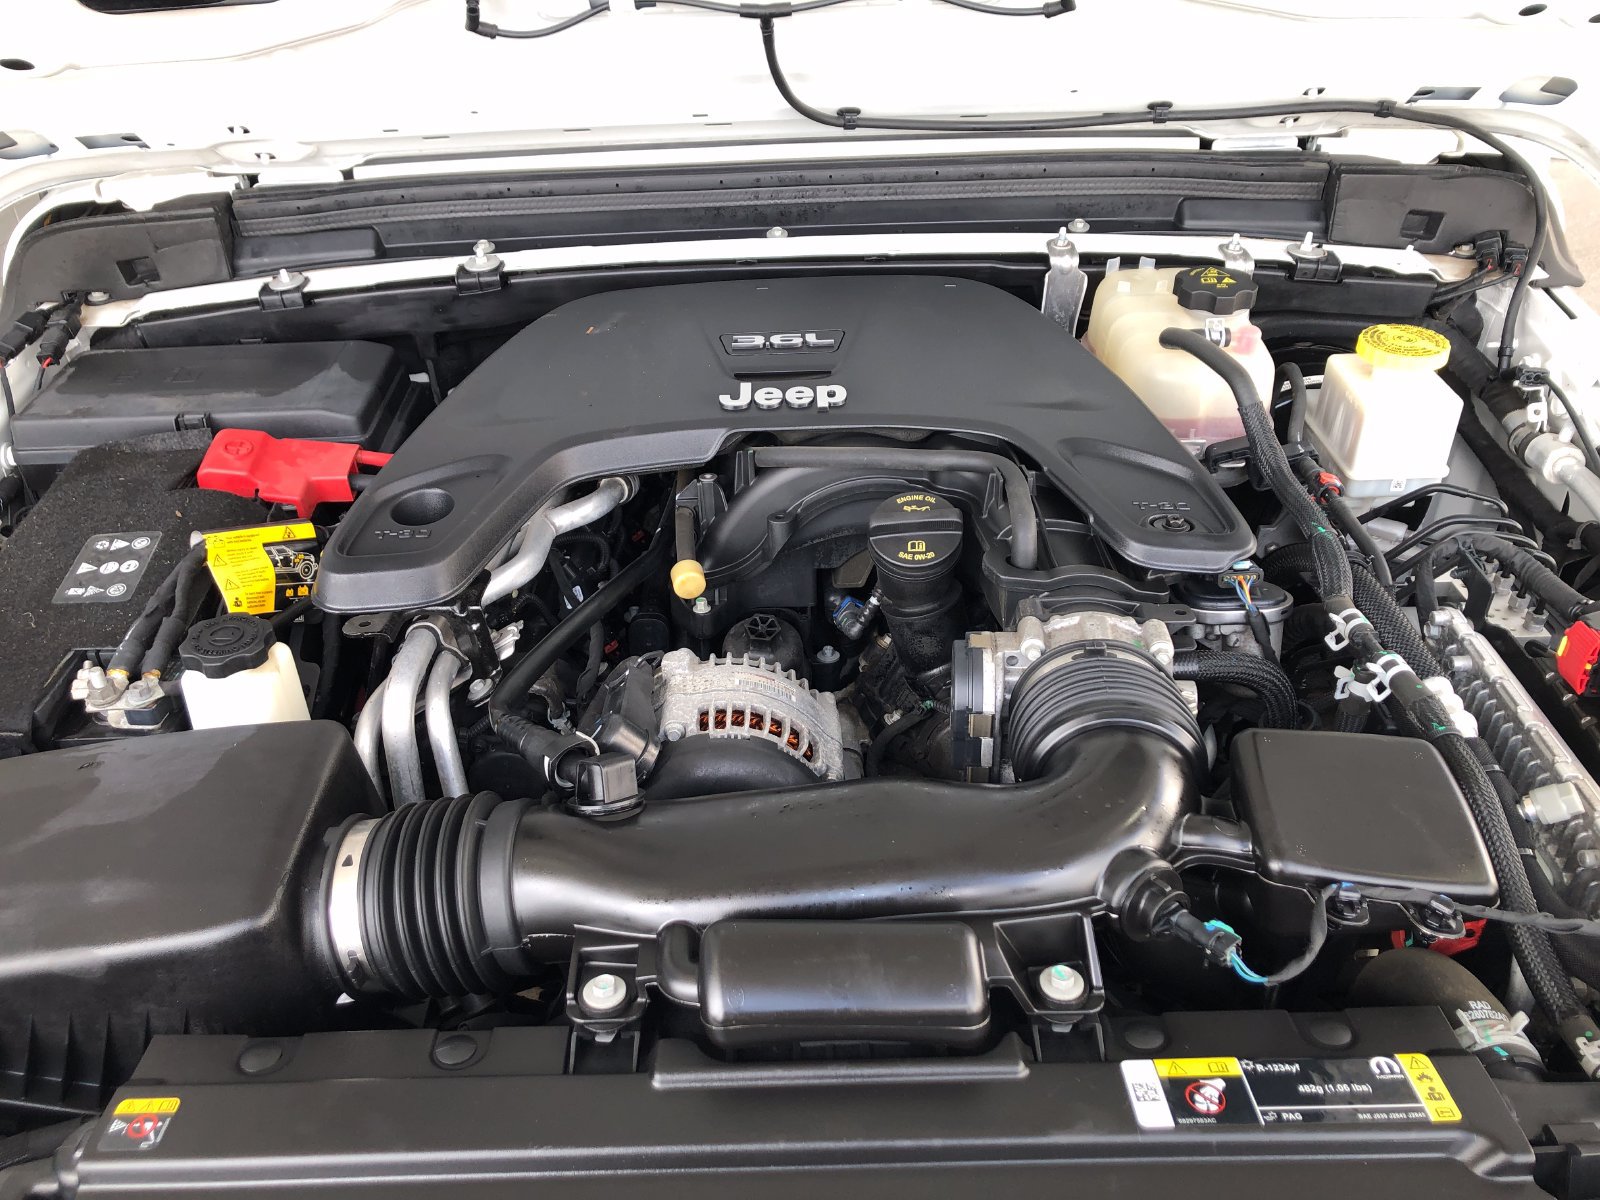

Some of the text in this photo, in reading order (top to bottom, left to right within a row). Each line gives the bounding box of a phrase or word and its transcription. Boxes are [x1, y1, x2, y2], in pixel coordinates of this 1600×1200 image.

[731, 333, 835, 350] 3.6L
[719, 382, 847, 412] Jeep
[896, 494, 936, 504] ENGINE OIL
[898, 551, 935, 560] SAE 0W-20
[1468, 1000, 1491, 1010] RAD
[1254, 1062, 1300, 1073] R-1234yf
[1281, 1112, 1303, 1121] PAG
